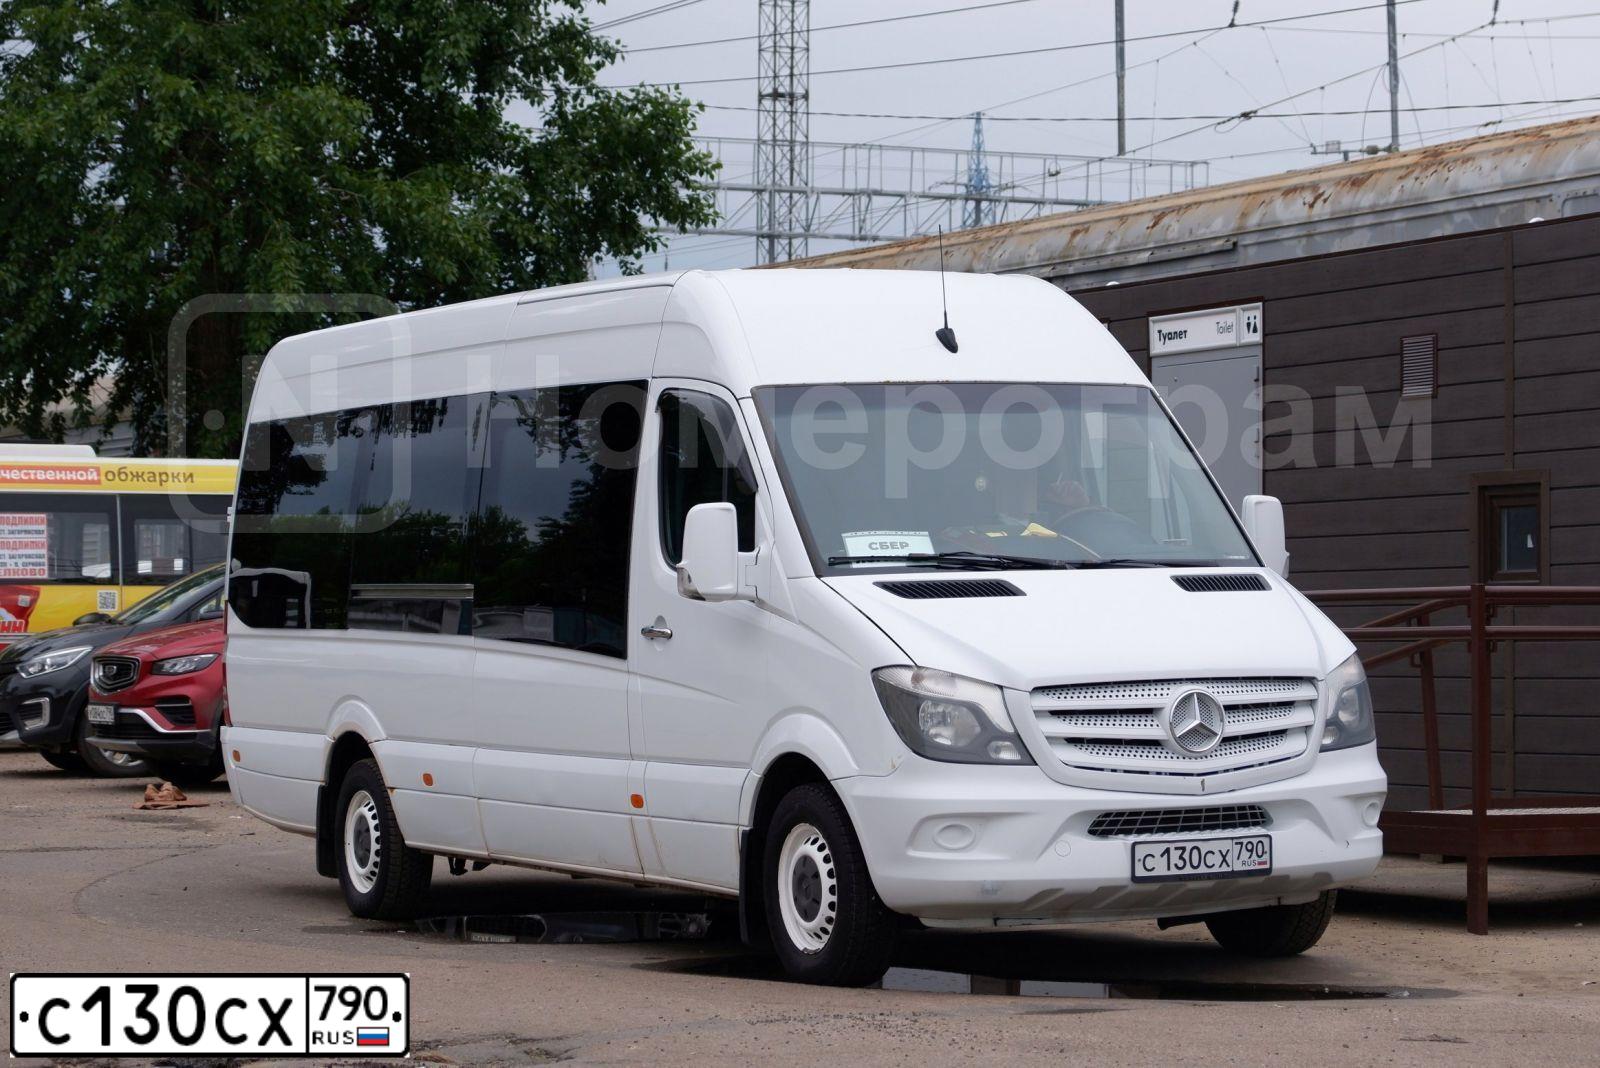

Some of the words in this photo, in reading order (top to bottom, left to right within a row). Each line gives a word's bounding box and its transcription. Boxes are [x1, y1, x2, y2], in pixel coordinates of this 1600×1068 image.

[1216, 320, 1234, 335] Toilet
[1157, 329, 1188, 345] Туалет
[104, 466, 195, 486] обжарки
[868, 541, 910, 551] СБЕР
[1142, 845, 1231, 872] С130СХ
[1234, 839, 1265, 861] 790
[1241, 859, 1257, 867] RUS
